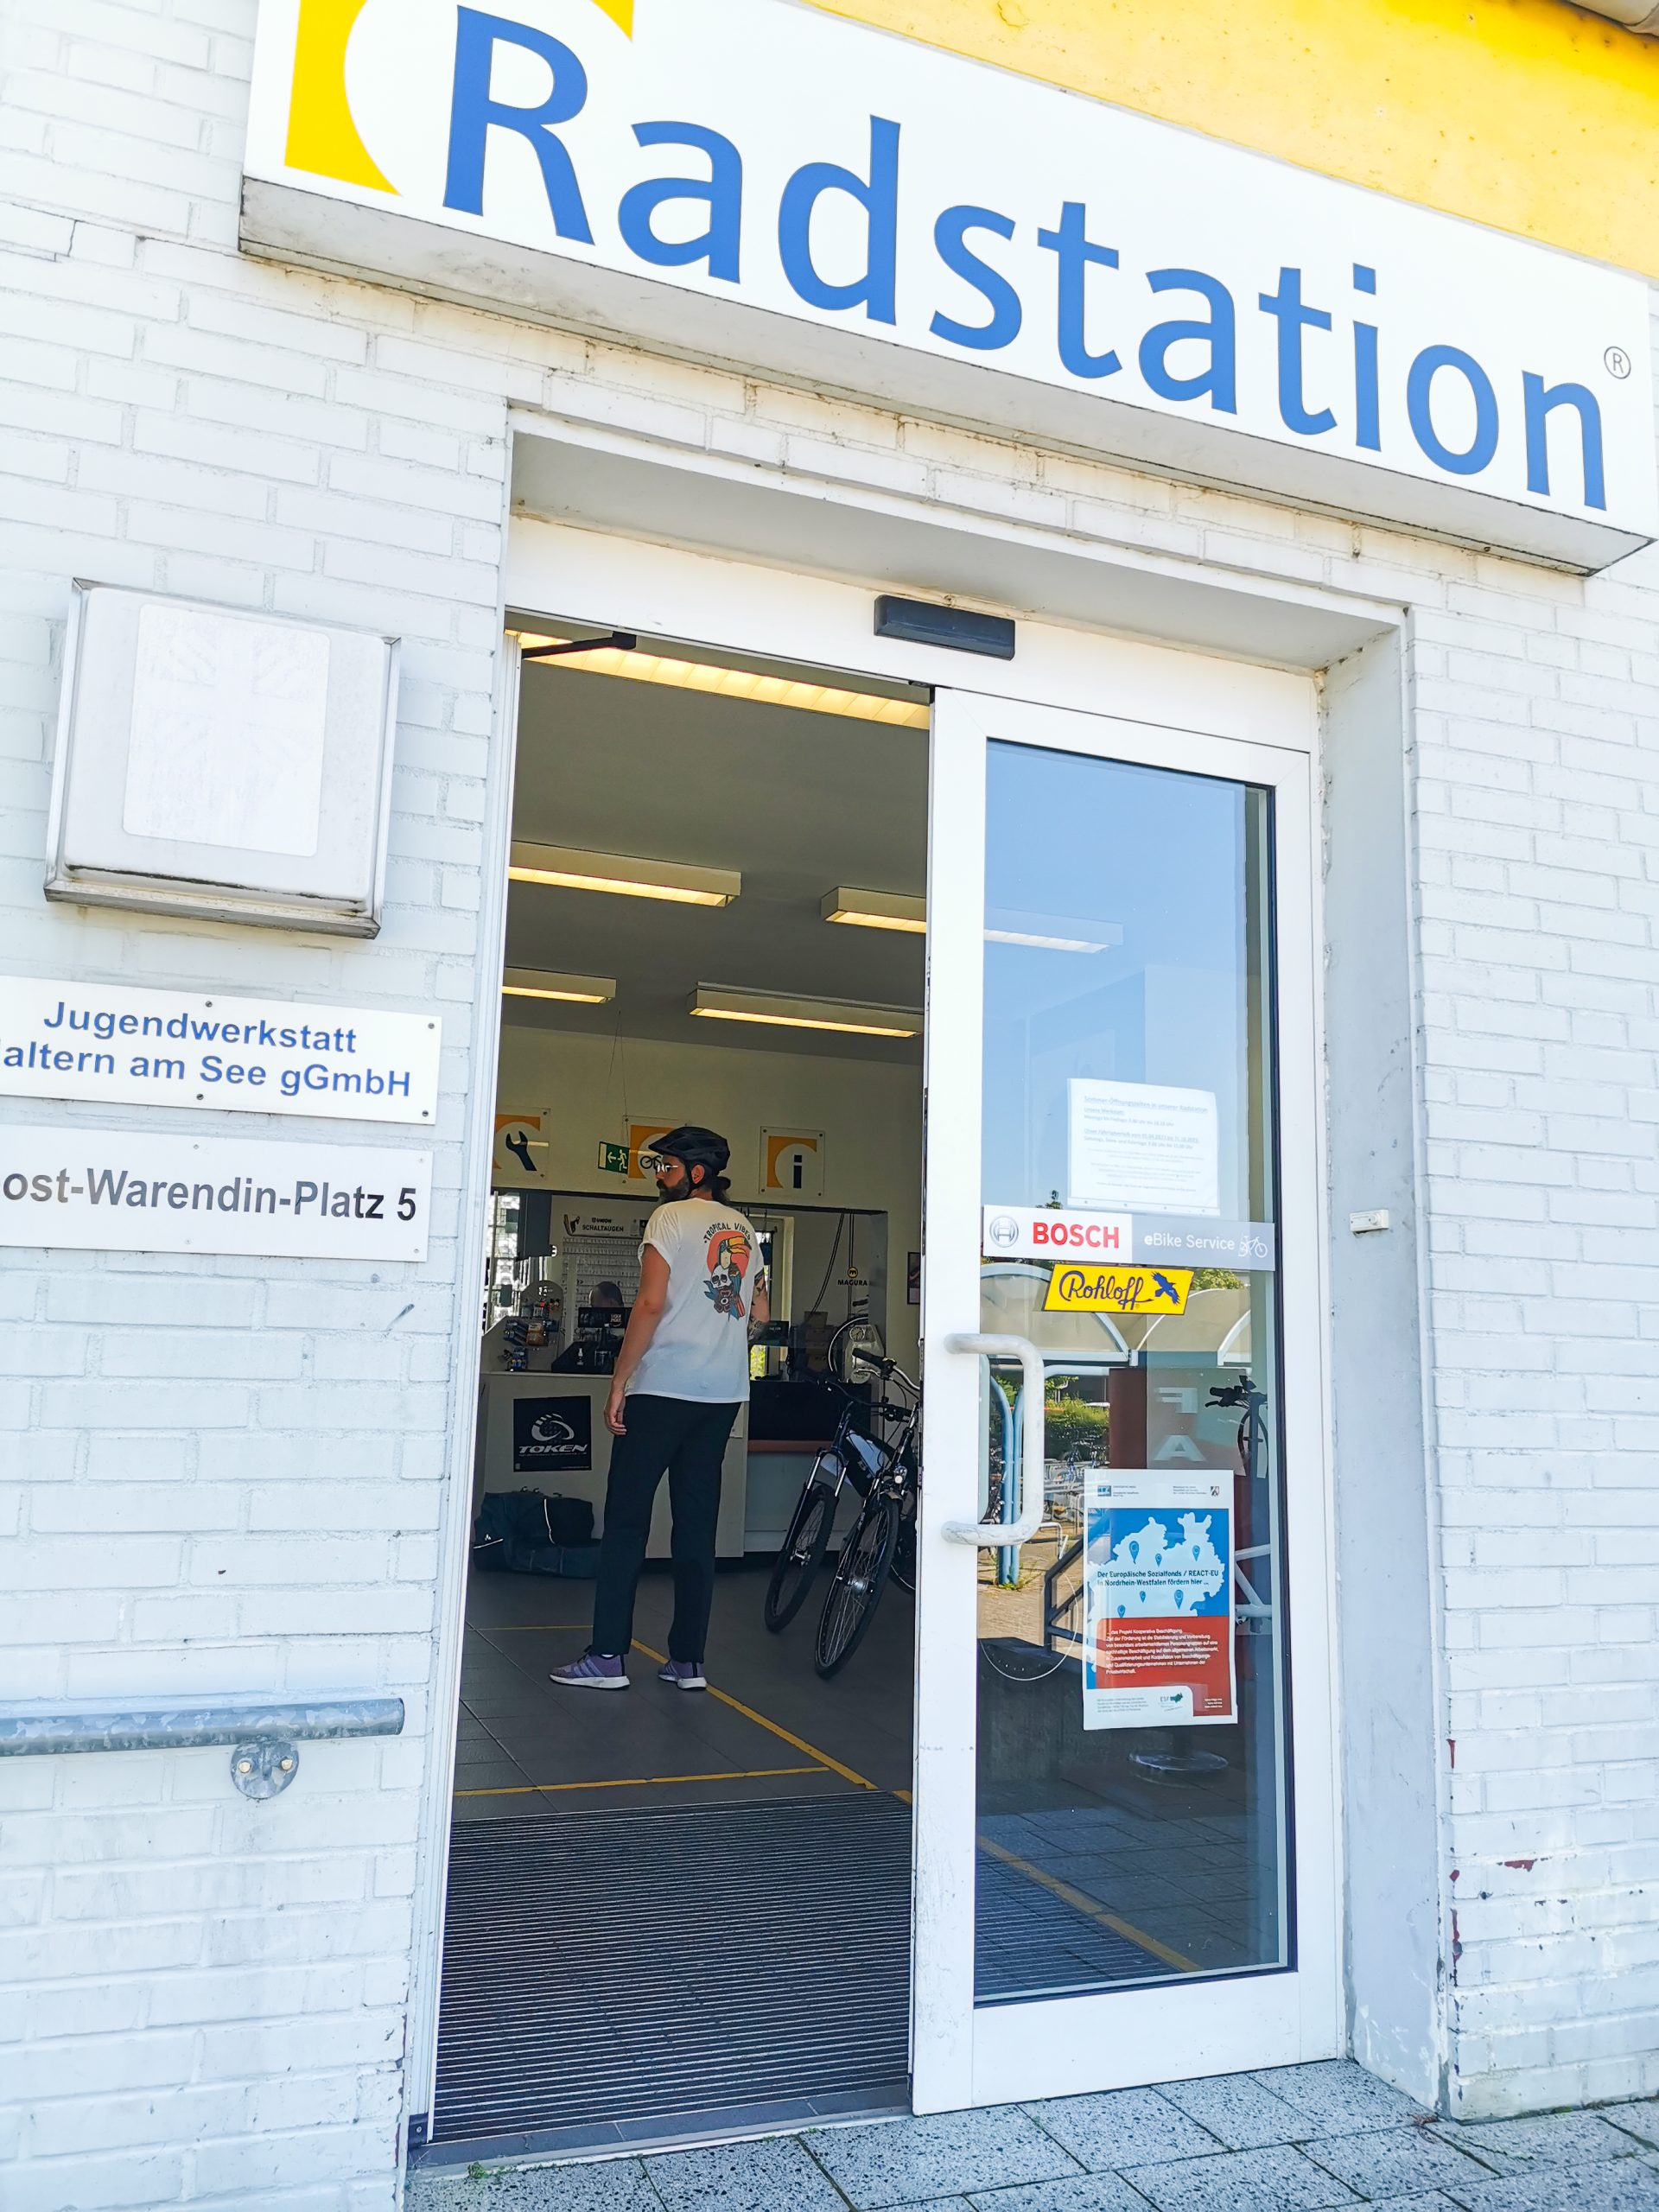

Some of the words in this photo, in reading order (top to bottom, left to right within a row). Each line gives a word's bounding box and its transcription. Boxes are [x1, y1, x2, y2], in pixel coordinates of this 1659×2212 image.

[443, 5, 1608, 512] Radstation
[44, 1001, 357, 1053] Jugendwerkstatt
[3, 1041, 115, 1075] altern
[130, 1055, 186, 1080] am
[200, 1056, 267, 1085] See
[280, 1064, 411, 1097] gGmbH
[3, 1168, 385, 1220] ost-Warendin-Platz
[397, 1187, 416, 1222] 5
[703, 1222, 732, 1241] TROPICAL
[734, 1222, 751, 1241] VIBES
[1033, 1222, 1119, 1249] BOSCH
[1144, 1233, 1182, 1247] eBike
[1185, 1235, 1235, 1250] Service
[1059, 1270, 1154, 1310] Rohloff
[518, 1444, 588, 1453] TOKEN
[1109, 1570, 1147, 1580] Europäische
